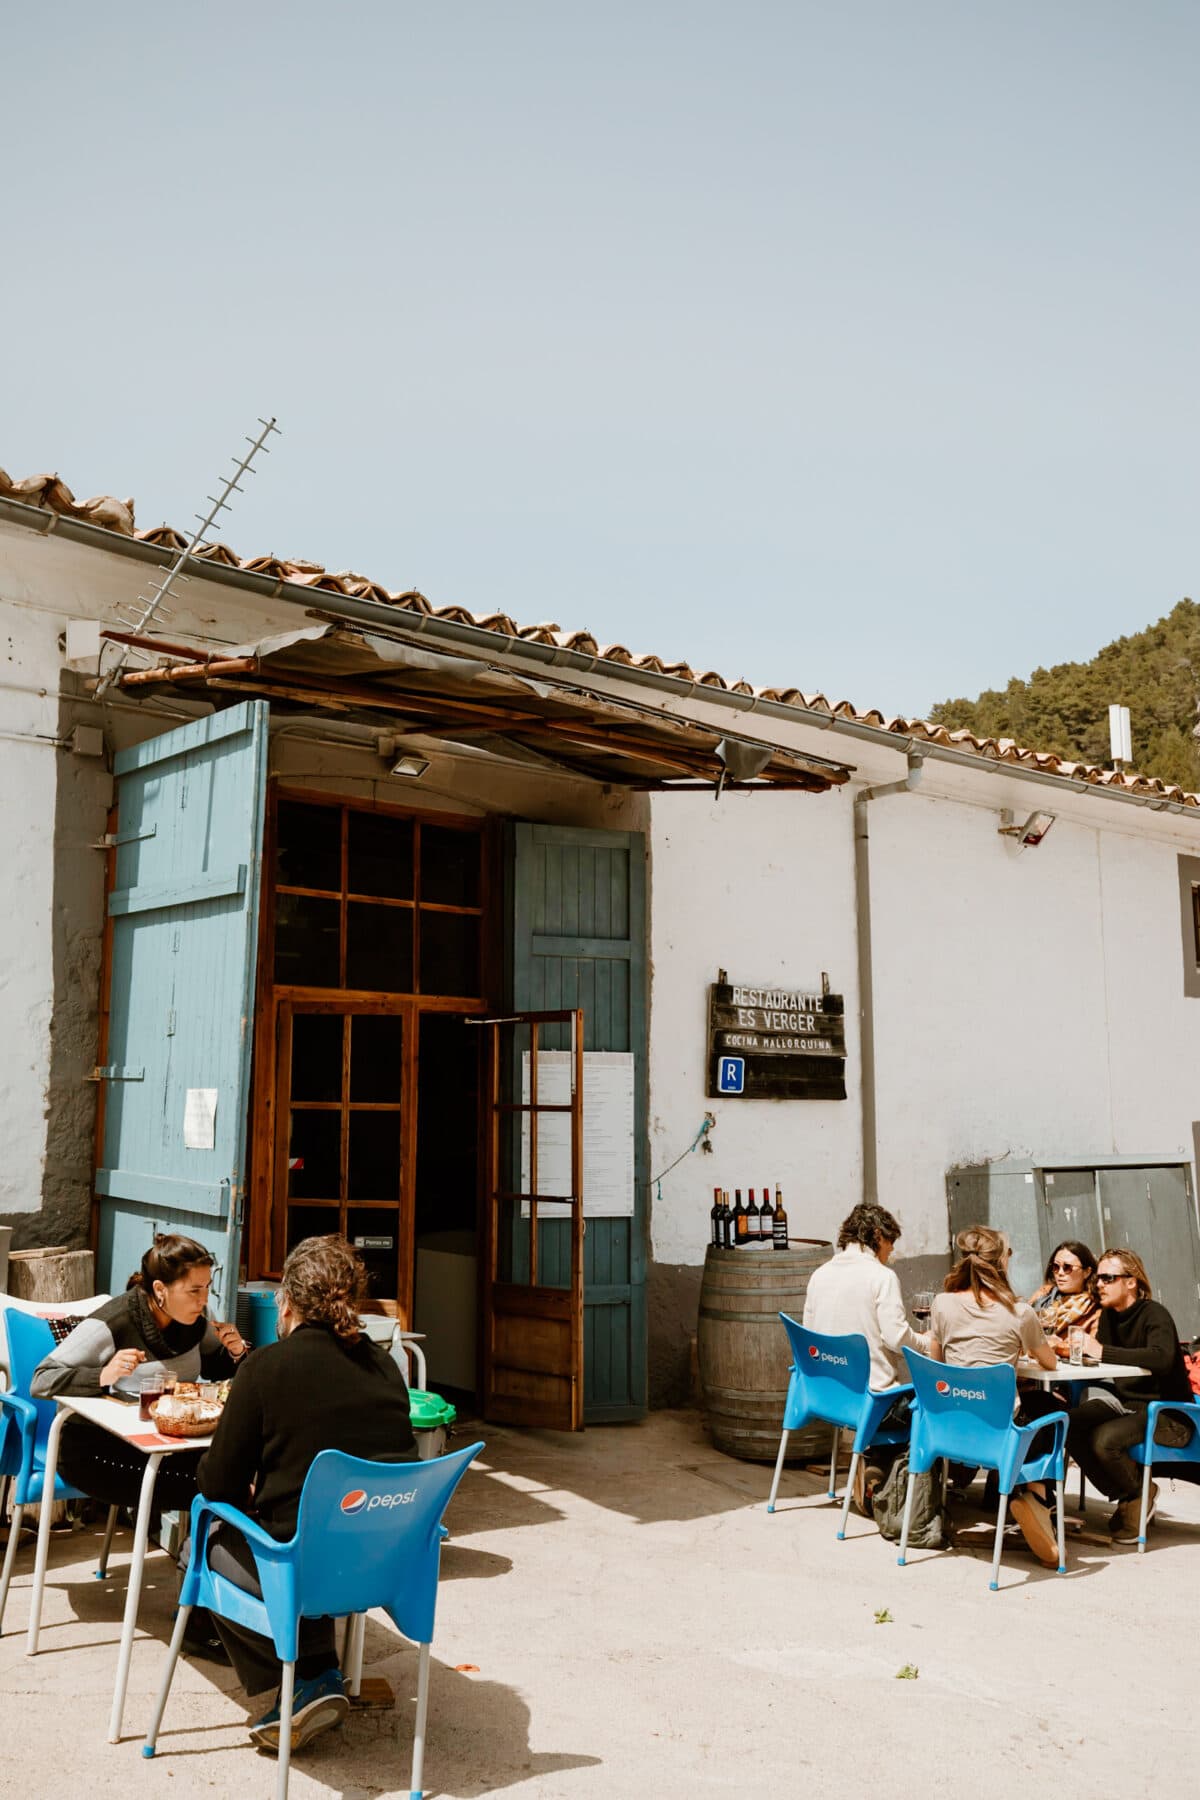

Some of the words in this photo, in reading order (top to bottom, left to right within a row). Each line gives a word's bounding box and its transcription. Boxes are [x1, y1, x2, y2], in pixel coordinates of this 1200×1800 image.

[732, 987, 823, 1012] RESTAURANTE
[737, 1009, 756, 1027] ES
[763, 1011, 815, 1031] VERGER
[726, 1034, 758, 1046] COCINA
[763, 1037, 831, 1050] MALLORQUINA
[727, 1063, 737, 1081] R
[821, 1352, 848, 1366] pepsi
[952, 1387, 986, 1401] pepsi
[366, 1488, 418, 1512] pepsi
